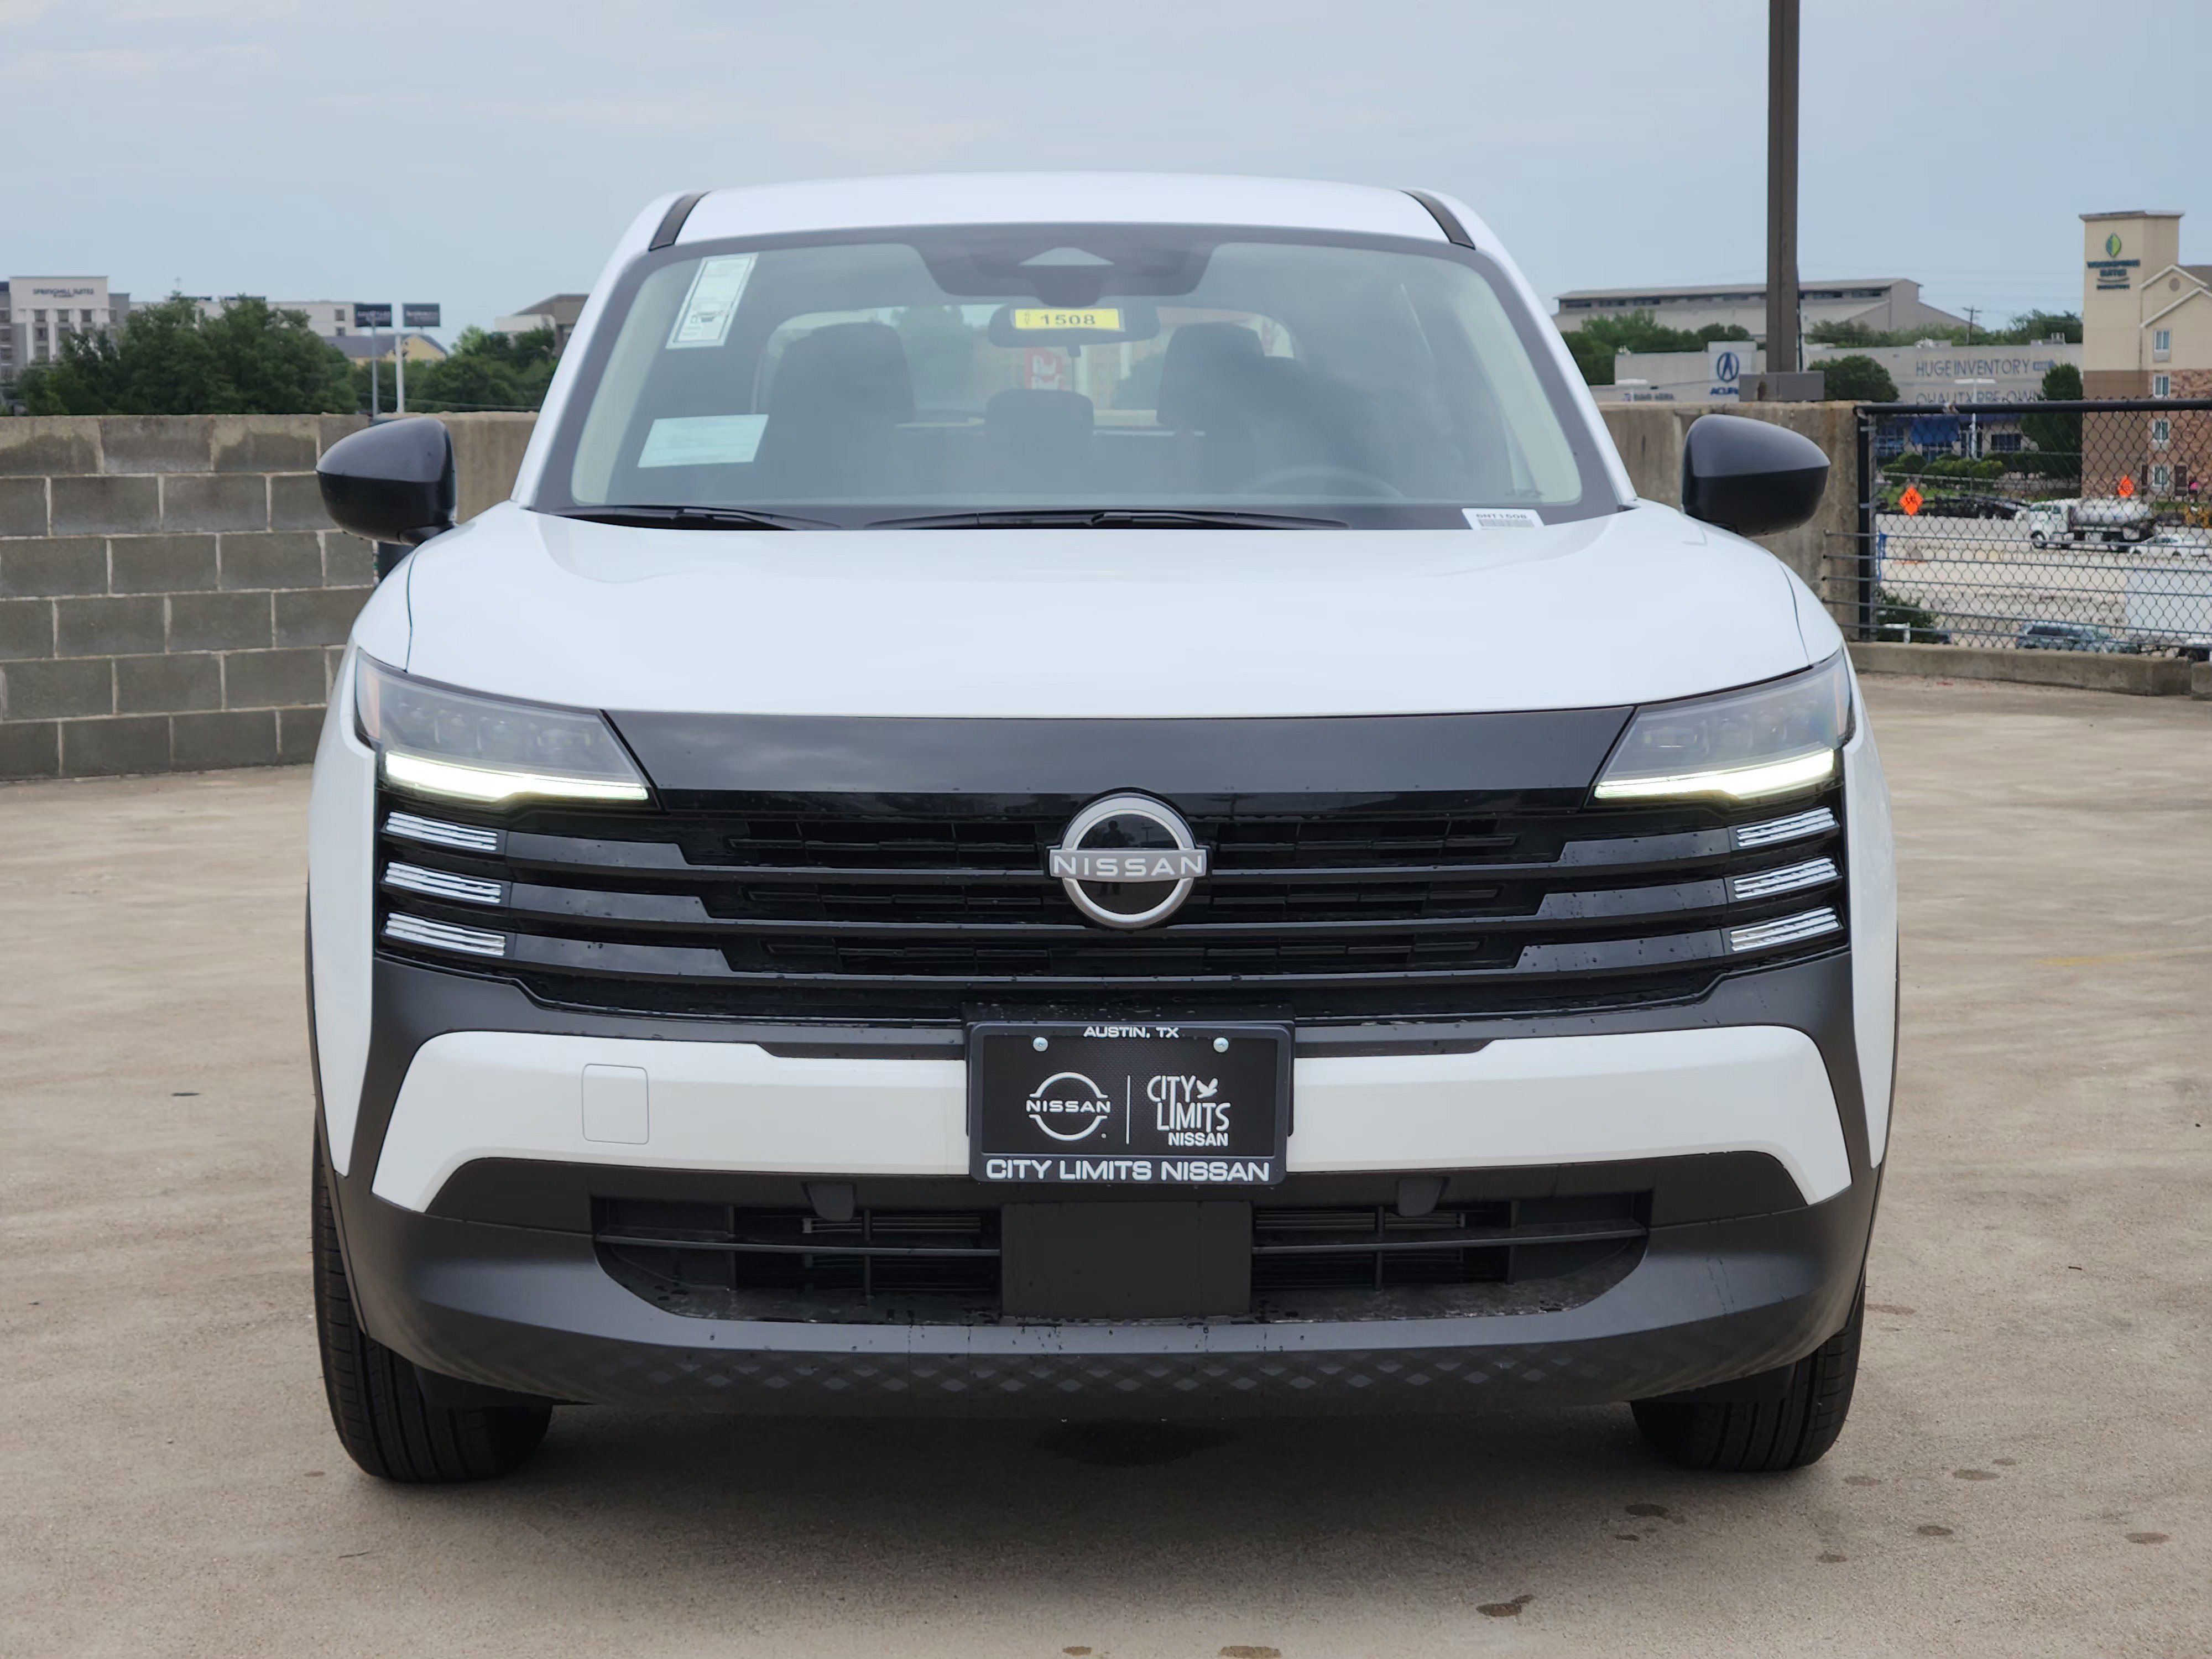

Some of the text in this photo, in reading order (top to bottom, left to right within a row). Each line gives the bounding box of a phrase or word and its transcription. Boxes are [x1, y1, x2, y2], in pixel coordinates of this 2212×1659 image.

[1040, 314, 1095, 325] 1508
[1916, 360, 1952, 377] HUGE
[1954, 359, 2030, 375] INVENTORY
[1710, 387, 1739, 395] ACUR
[1053, 855, 1202, 877] NISSAN
[1155, 1027, 1180, 1038] TX
[1147, 1075, 1196, 1105] CITY
[1026, 1100, 1111, 1113] NISSAN
[1157, 1102, 1231, 1133] LIMITS
[1168, 1132, 1229, 1146] NISSAN
[986, 1159, 1270, 1182] CITY LIMITS NISSAN
